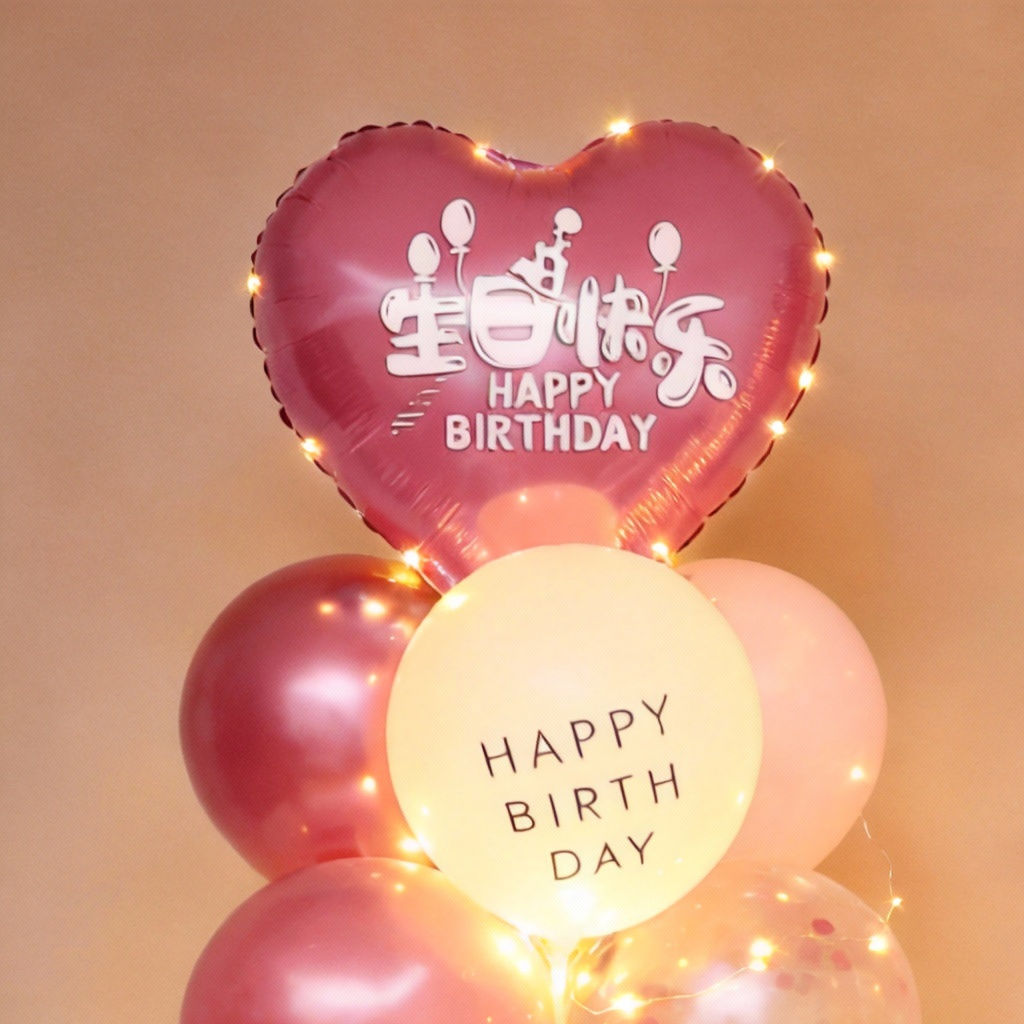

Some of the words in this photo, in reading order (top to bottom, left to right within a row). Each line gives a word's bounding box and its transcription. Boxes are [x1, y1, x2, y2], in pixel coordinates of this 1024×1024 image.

[380, 273, 738, 407] 生日快乐
[488, 371, 622, 410] HAPPY
[445, 412, 657, 452] BIRTHDAY
[480, 693, 667, 778] HAPPY
[504, 762, 680, 833] BIRTH
[550, 831, 654, 881] DAY
